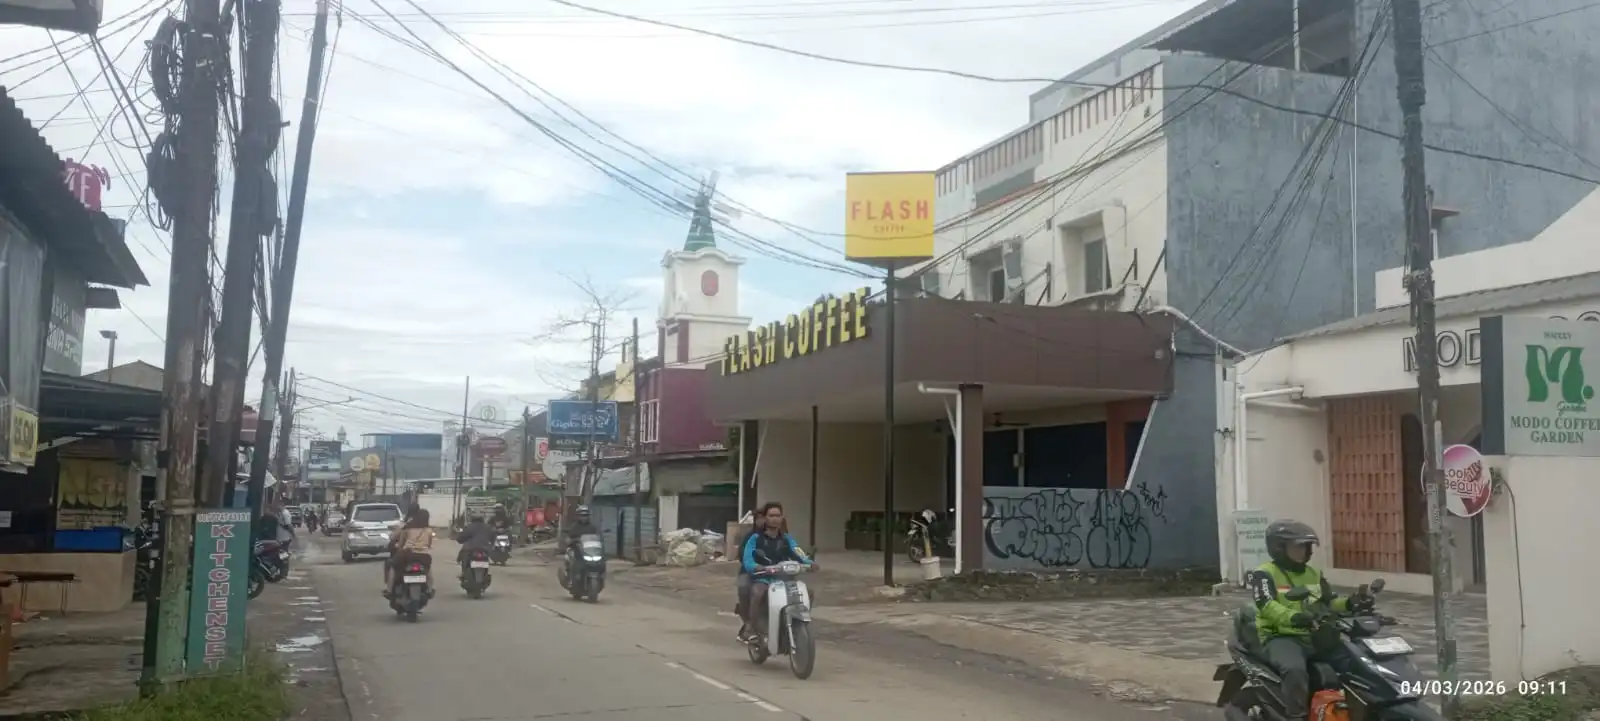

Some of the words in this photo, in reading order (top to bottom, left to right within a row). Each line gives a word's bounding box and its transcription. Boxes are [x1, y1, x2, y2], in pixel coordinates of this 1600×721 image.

[852, 200, 928, 220] FLASH
[720, 320, 780, 377] FLASH
[783, 286, 870, 360] COFFEE
[1511, 416, 1551, 429] MODO
[1530, 430, 1585, 444] GARDEN
[203, 524, 235, 672] KITCHENSET
